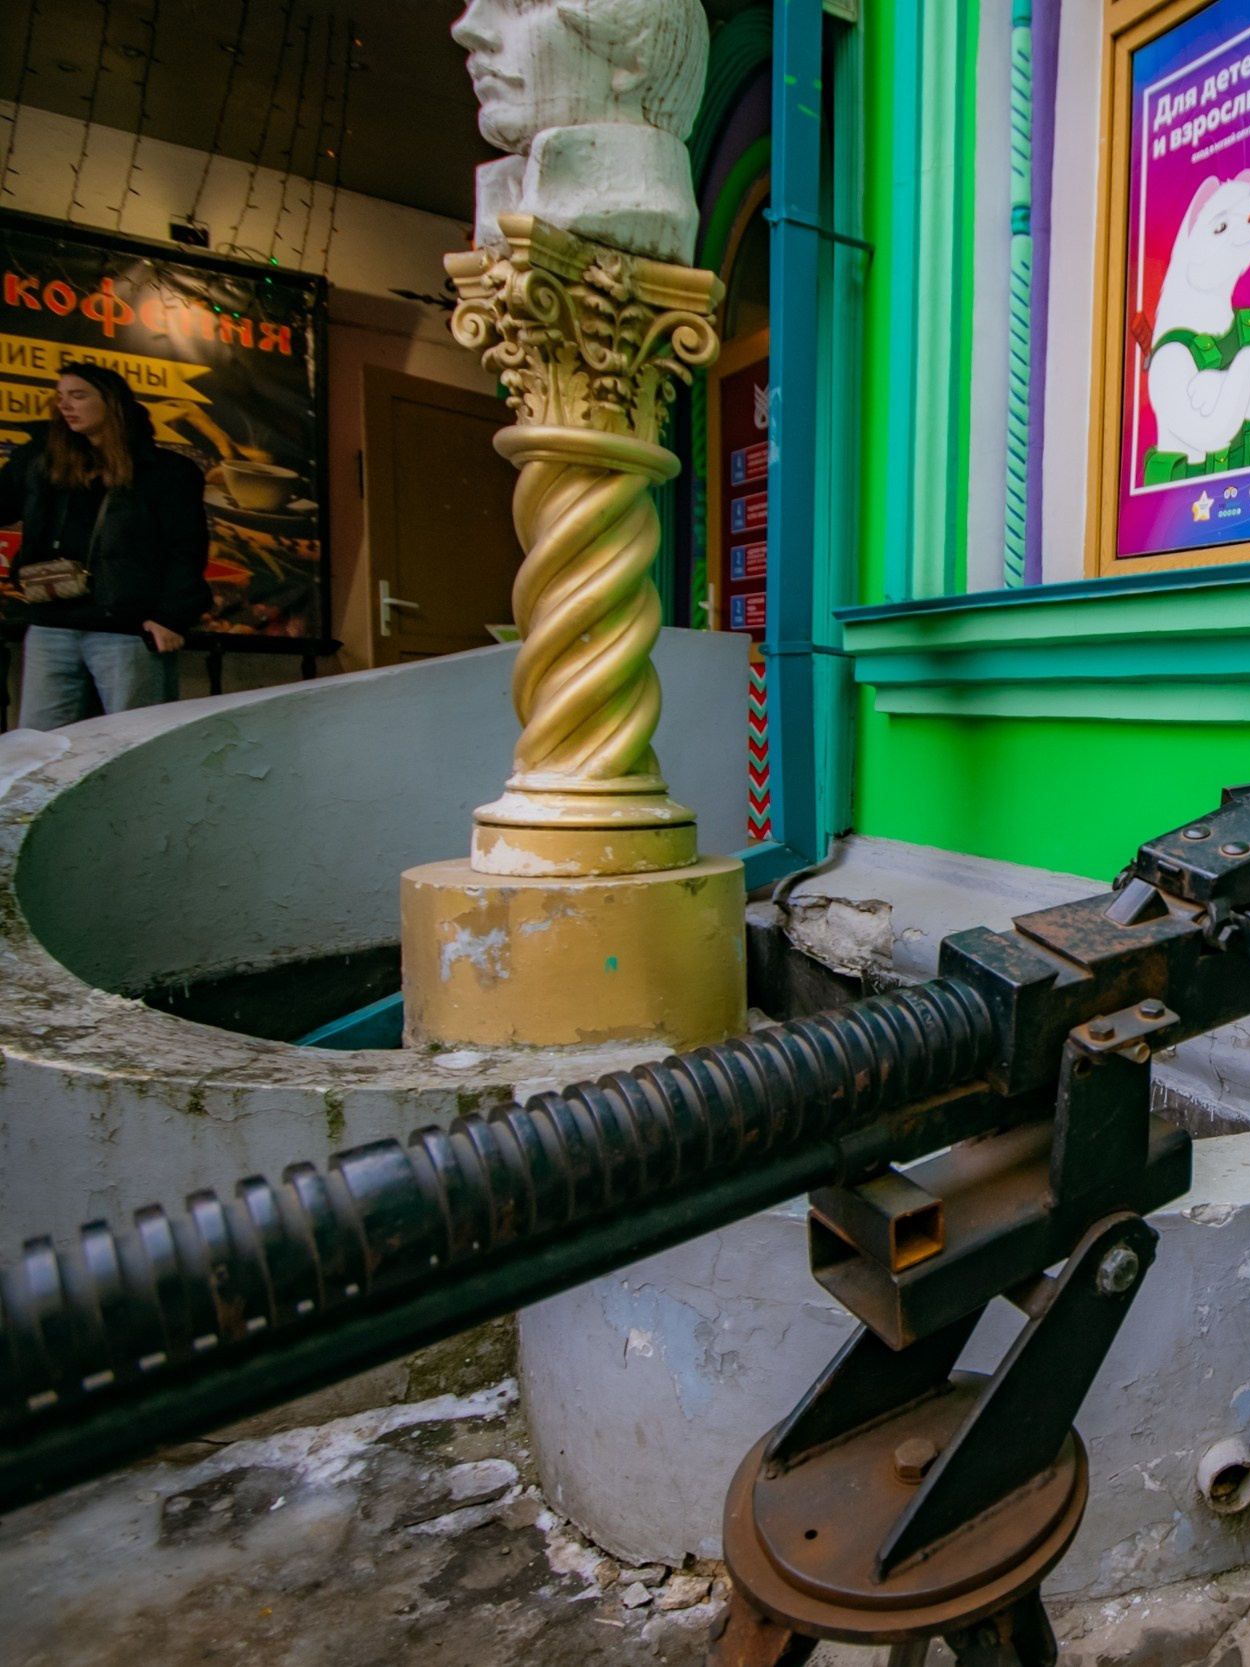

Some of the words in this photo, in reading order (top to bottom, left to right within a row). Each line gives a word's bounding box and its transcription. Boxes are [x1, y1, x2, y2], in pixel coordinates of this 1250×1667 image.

[1153, 86, 1198, 133] Для
[1153, 135, 1167, 160] и
[0, 341, 46, 370] ИЕ
